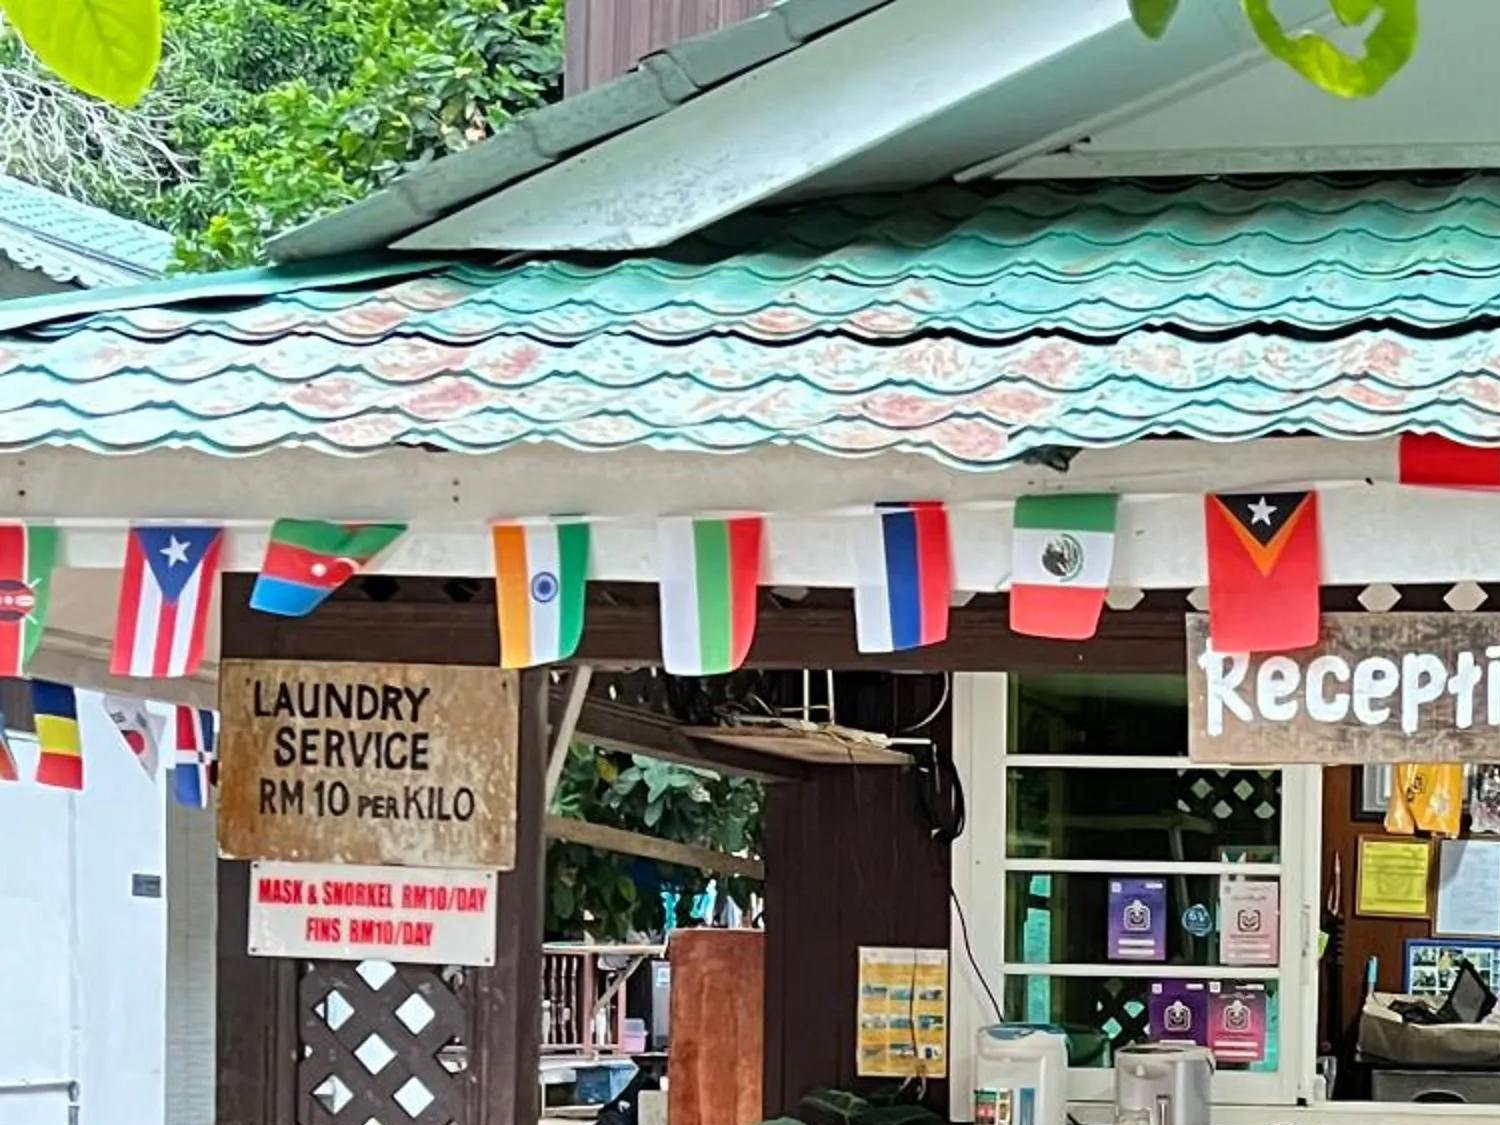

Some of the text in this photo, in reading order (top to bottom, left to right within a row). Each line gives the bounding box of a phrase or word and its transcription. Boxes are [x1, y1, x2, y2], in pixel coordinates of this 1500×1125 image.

[253, 680, 430, 723] LAUNDRY
[274, 727, 430, 771] SERVICE
[259, 778, 475, 822] RM 10 PER KILO
[258, 878, 487, 912] MASK & SNORKEL RM10/DAY
[306, 917, 435, 946] FINS RM10/DAY
